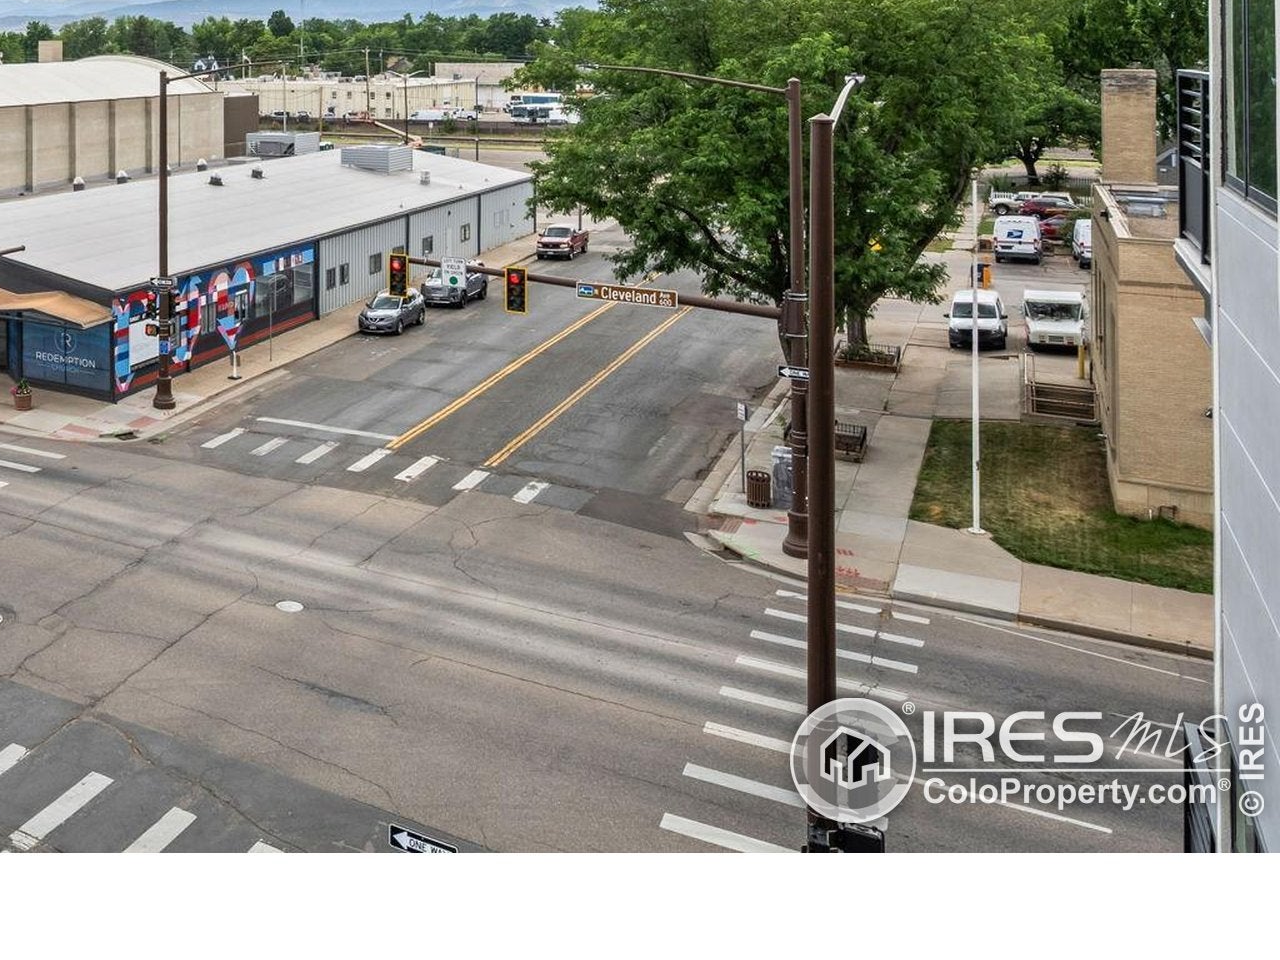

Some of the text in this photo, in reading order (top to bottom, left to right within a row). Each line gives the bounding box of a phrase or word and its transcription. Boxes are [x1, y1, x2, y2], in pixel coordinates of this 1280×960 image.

[600, 286, 657, 304] Cleveland
[35, 351, 96, 369] REDEMPTION
[409, 839, 427, 851] ONE
